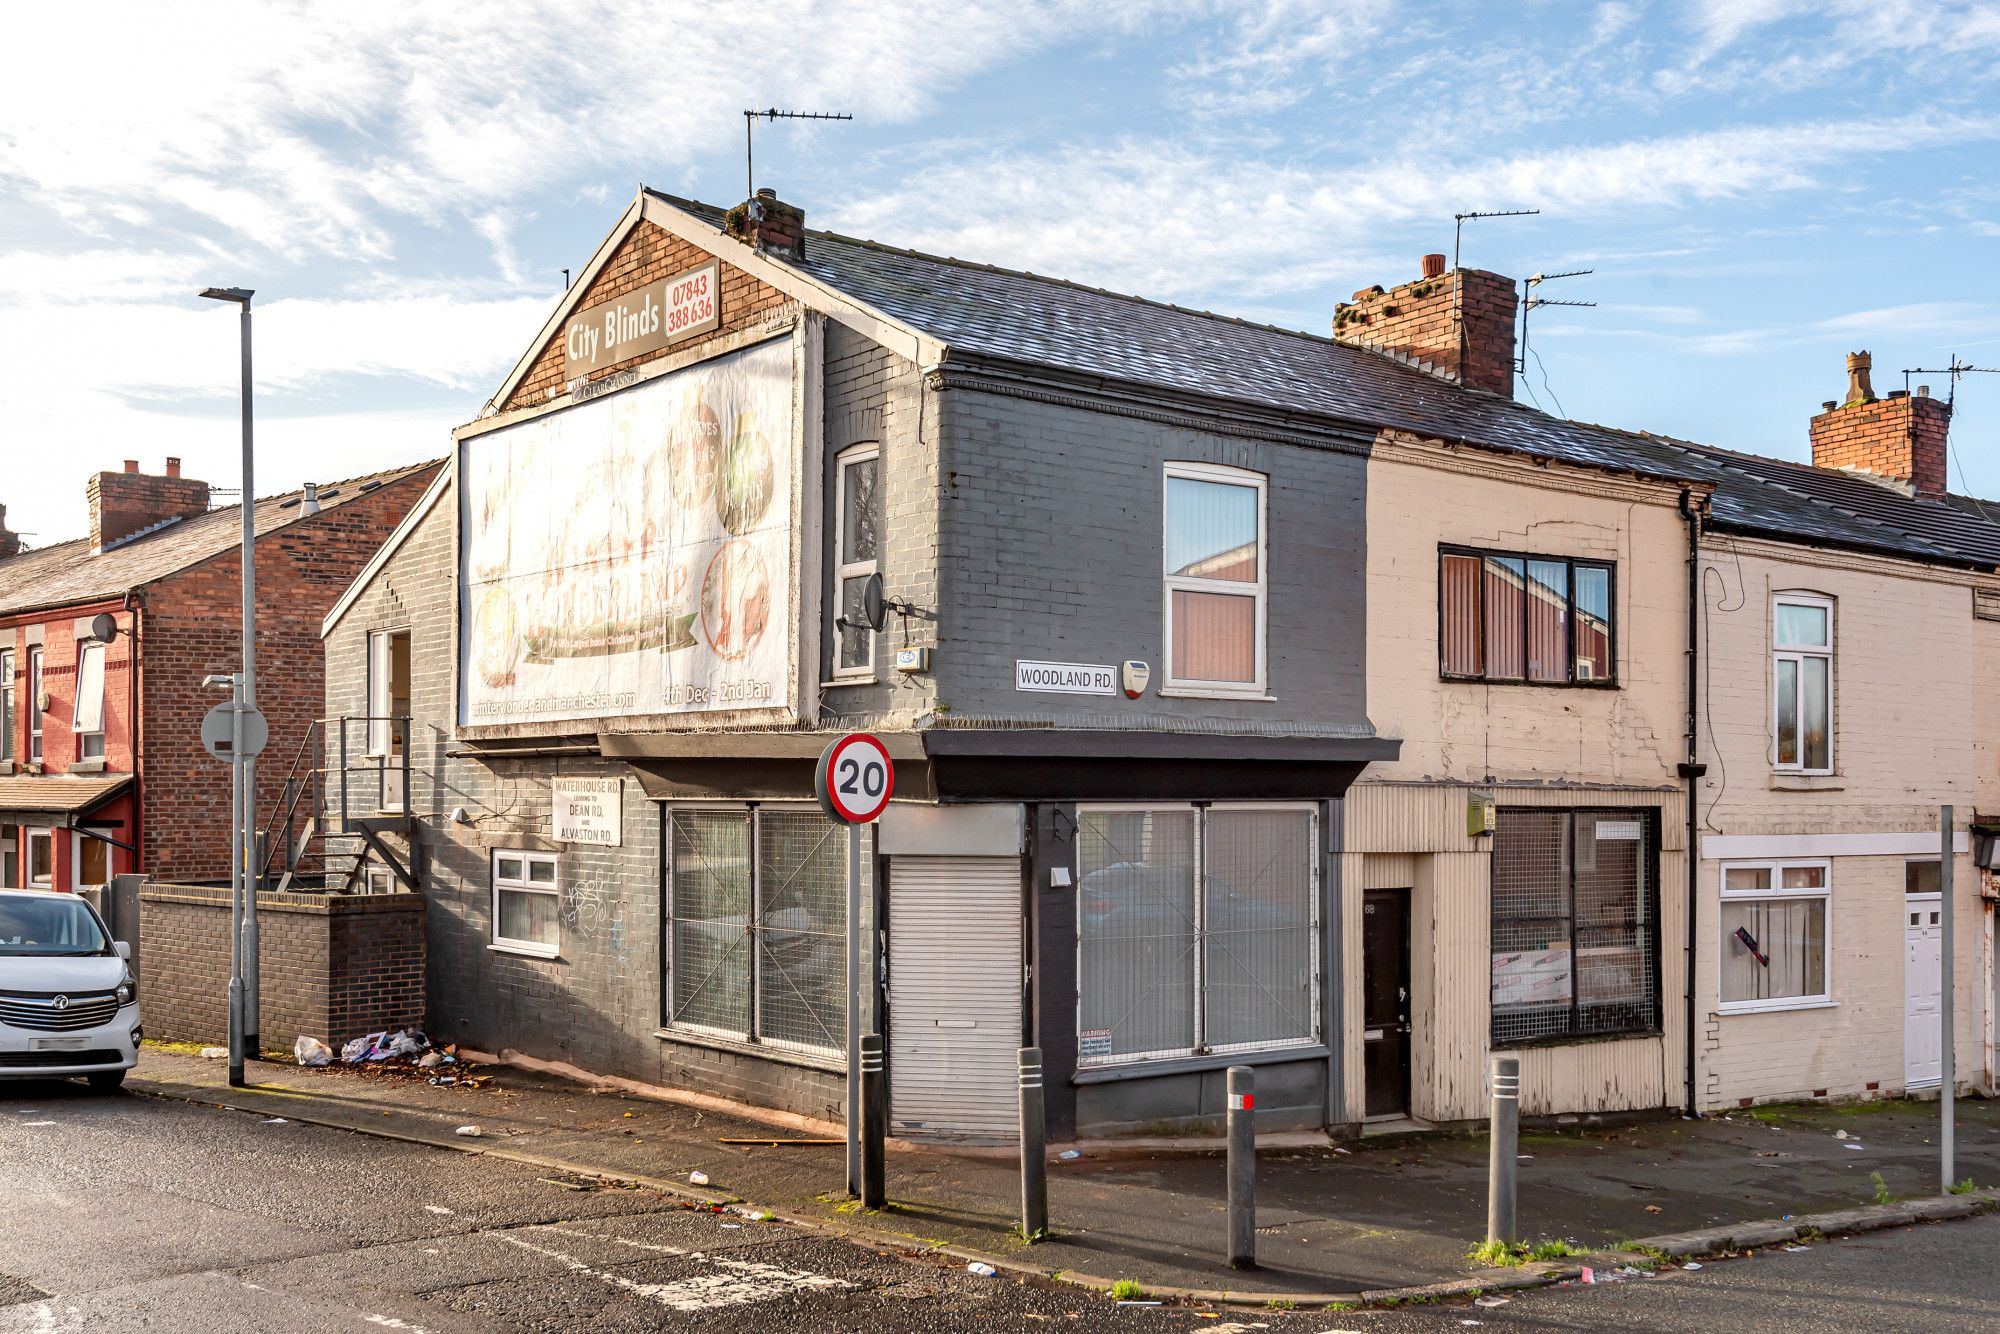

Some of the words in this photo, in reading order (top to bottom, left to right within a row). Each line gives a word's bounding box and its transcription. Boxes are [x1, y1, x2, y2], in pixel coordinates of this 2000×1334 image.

[673, 274, 707, 306] 07843
[668, 305, 689, 333] 388
[691, 297, 713, 323] 636
[568, 323, 599, 364] City
[605, 294, 659, 349] Blinds
[1021, 668, 1091, 687] WOODLAND
[1094, 673, 1113, 689] RD.
[685, 684, 709, 704] Dec
[720, 679, 744, 702] 2nd
[747, 679, 770, 700] Jan
[555, 780, 606, 794] WATERHOUSE
[607, 781, 620, 794] RD.
[839, 758, 885, 798] 20
[569, 804, 590, 817] DEAN
[591, 804, 604, 818] RD.
[561, 827, 599, 842] ALVASTON
[600, 830, 613, 843] RD.
